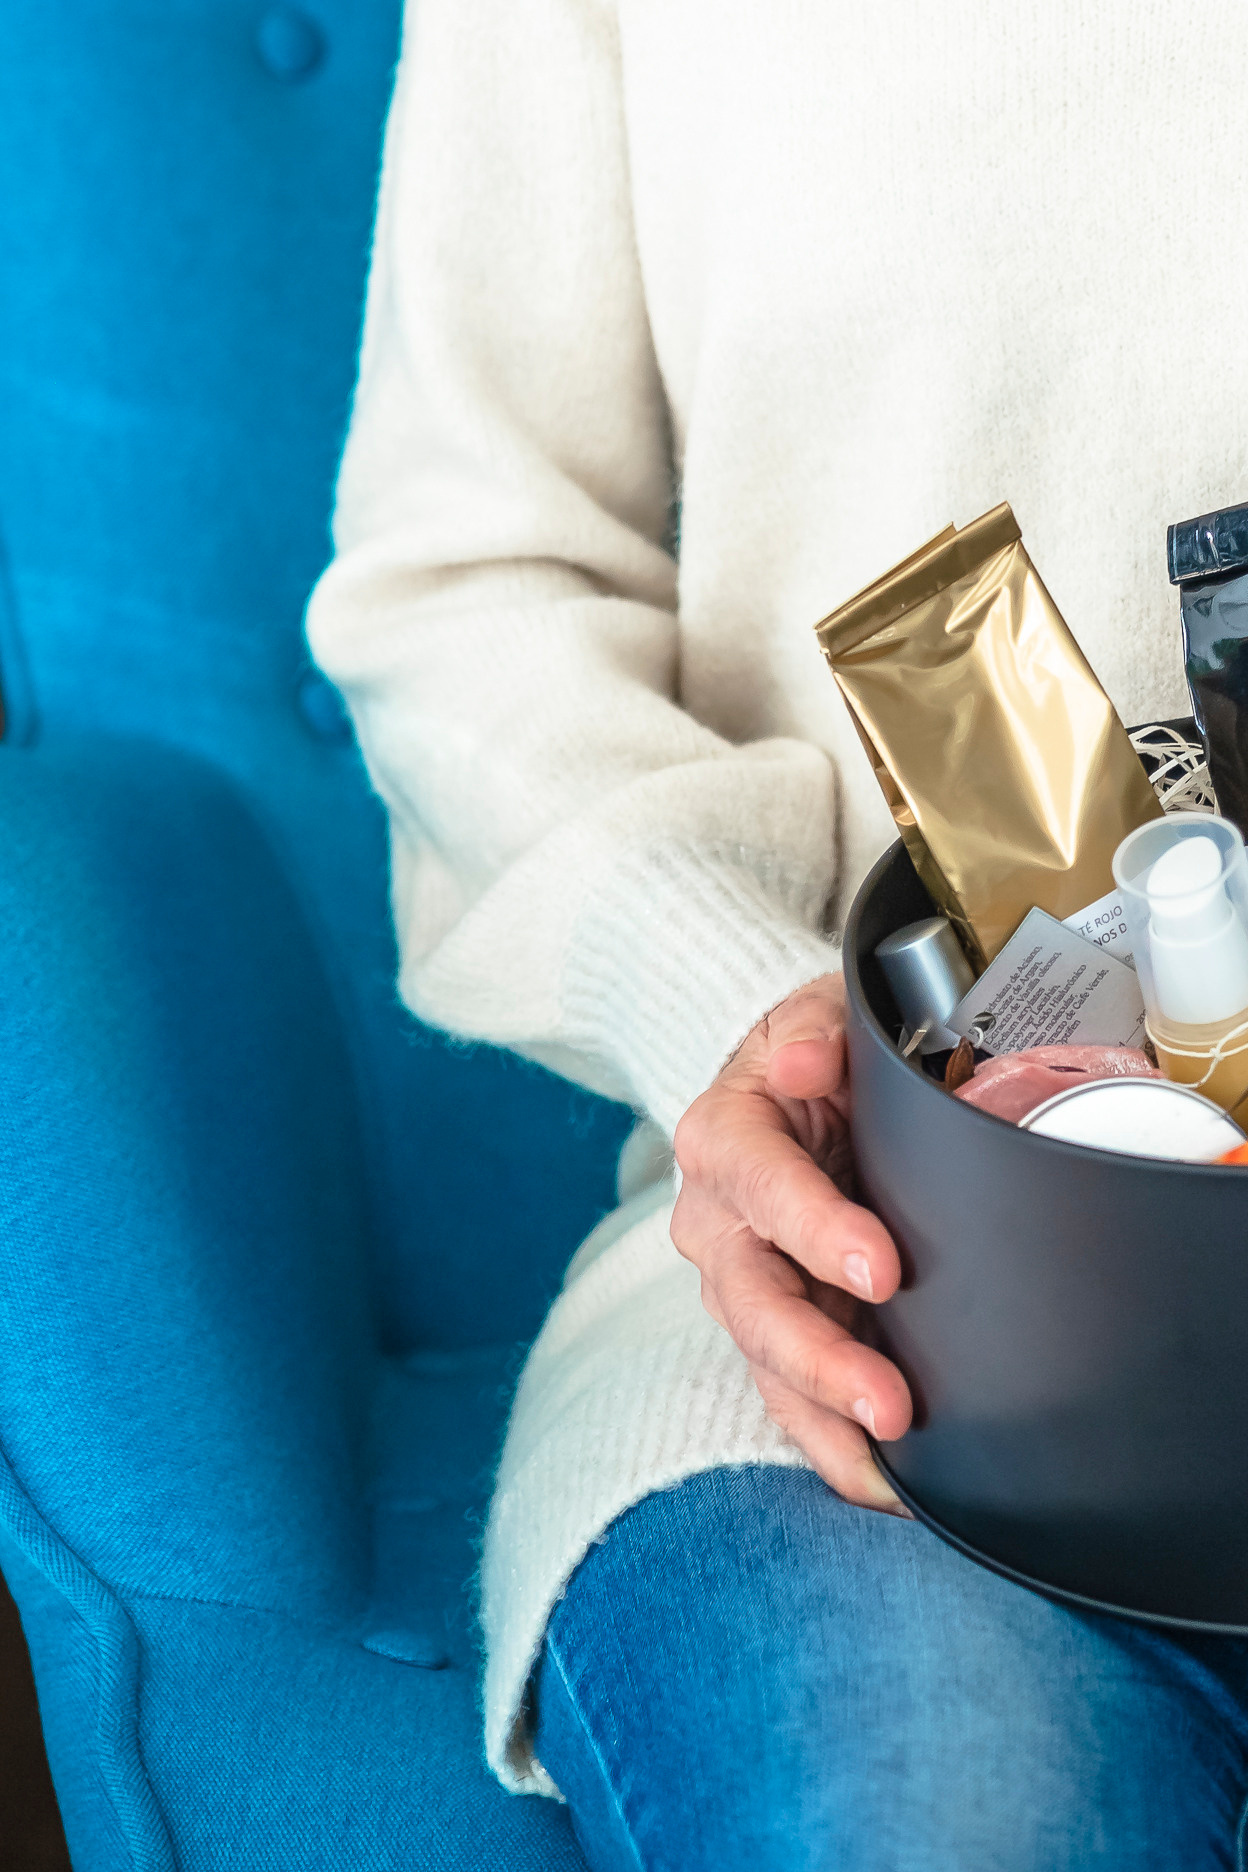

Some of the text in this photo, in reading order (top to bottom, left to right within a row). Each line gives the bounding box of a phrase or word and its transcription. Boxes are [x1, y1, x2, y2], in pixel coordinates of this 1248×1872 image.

[1078, 905, 1123, 937] TÉ ROJO
[985, 981, 1011, 1012] idrolato
[1008, 971, 1019, 983] de
[1011, 982, 1022, 994] de
[1008, 1000, 1020, 1013] de
[1042, 994, 1077, 1031] molecular,
[992, 1018, 1018, 1050] Sodium
[1044, 1018, 1067, 1046] xtracto
[1063, 1008, 1074, 1020] de
